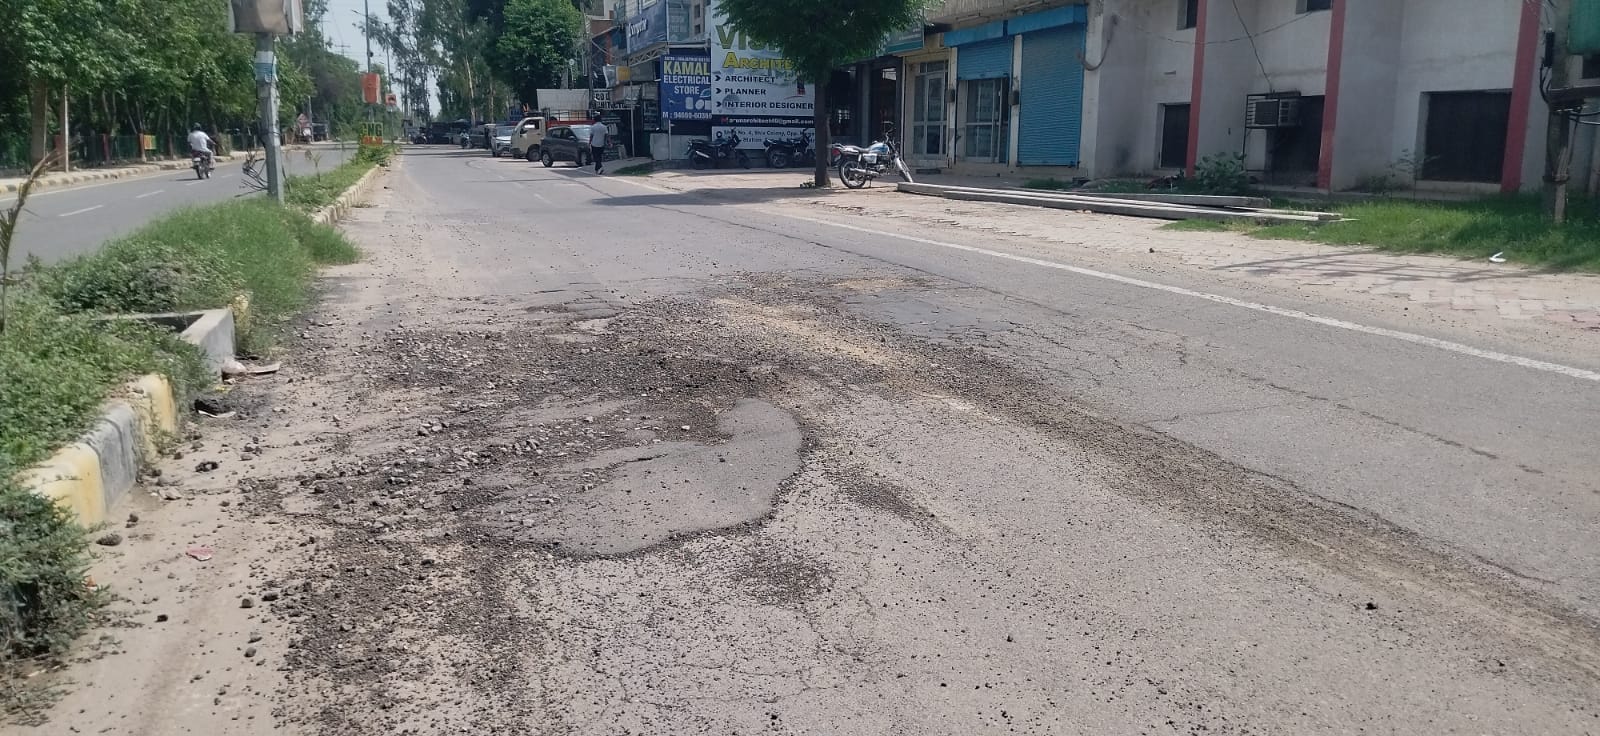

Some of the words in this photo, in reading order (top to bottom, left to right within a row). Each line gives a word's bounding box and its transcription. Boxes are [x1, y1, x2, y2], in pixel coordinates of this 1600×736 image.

[723, 52, 793, 69] ARCHITE
[664, 60, 711, 75] KAMAL
[664, 75, 711, 84] ELECTRICAL
[725, 75, 775, 83] ARCHITECT
[674, 85, 700, 94] STORE
[725, 101, 767, 109] INTERIOR
[769, 102, 814, 110] DESIGNER
